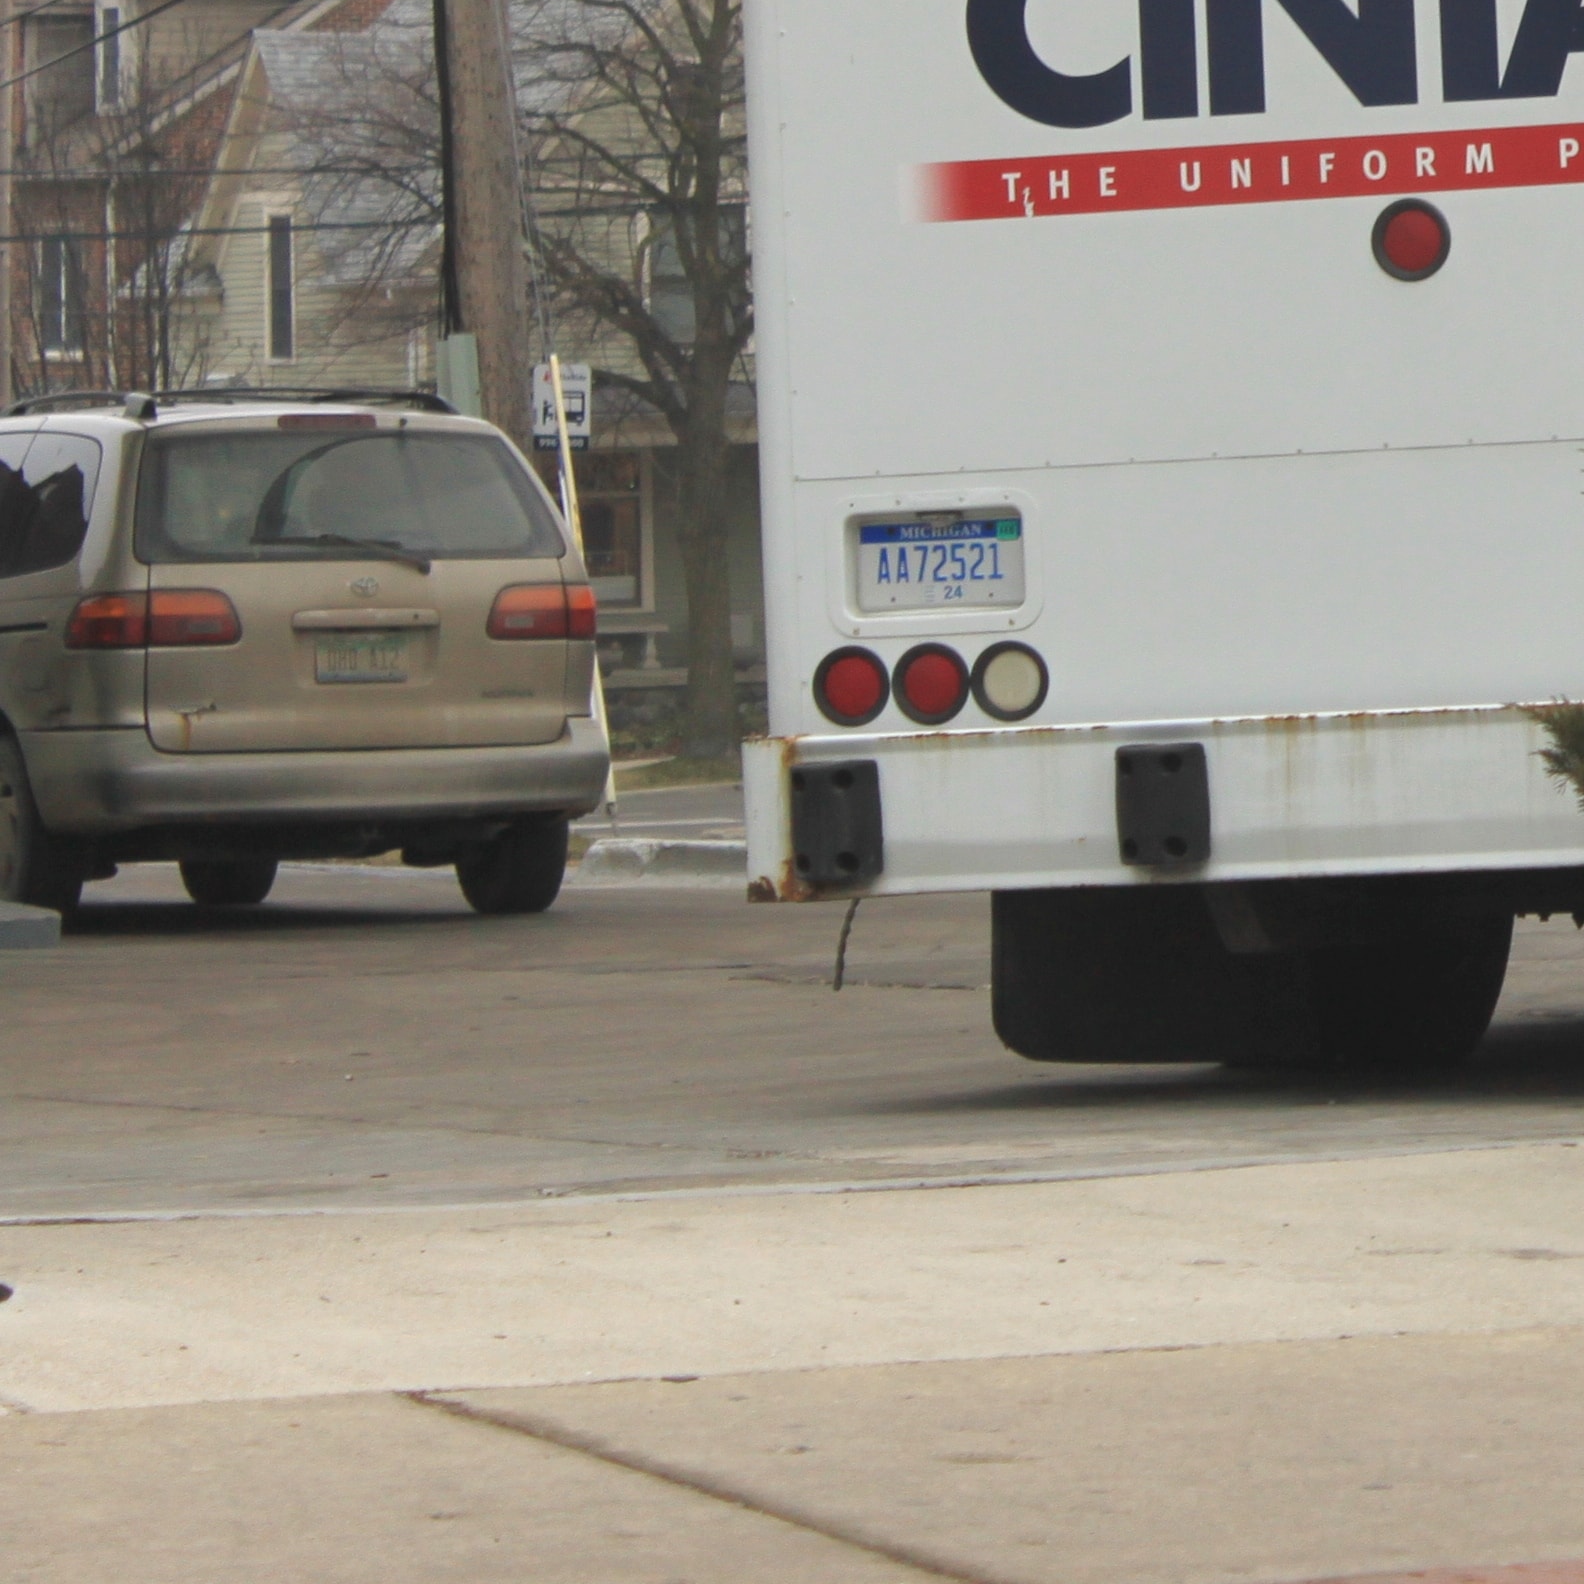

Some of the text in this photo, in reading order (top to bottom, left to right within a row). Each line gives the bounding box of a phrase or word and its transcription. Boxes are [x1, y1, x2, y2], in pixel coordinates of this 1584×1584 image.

[1001, 165, 1118, 204] THE
[1179, 142, 1495, 193] UNIFORM
[899, 523, 982, 540] MICHIGAN
[876, 542, 1004, 585] AA72521
[943, 584, 963, 601] 24
